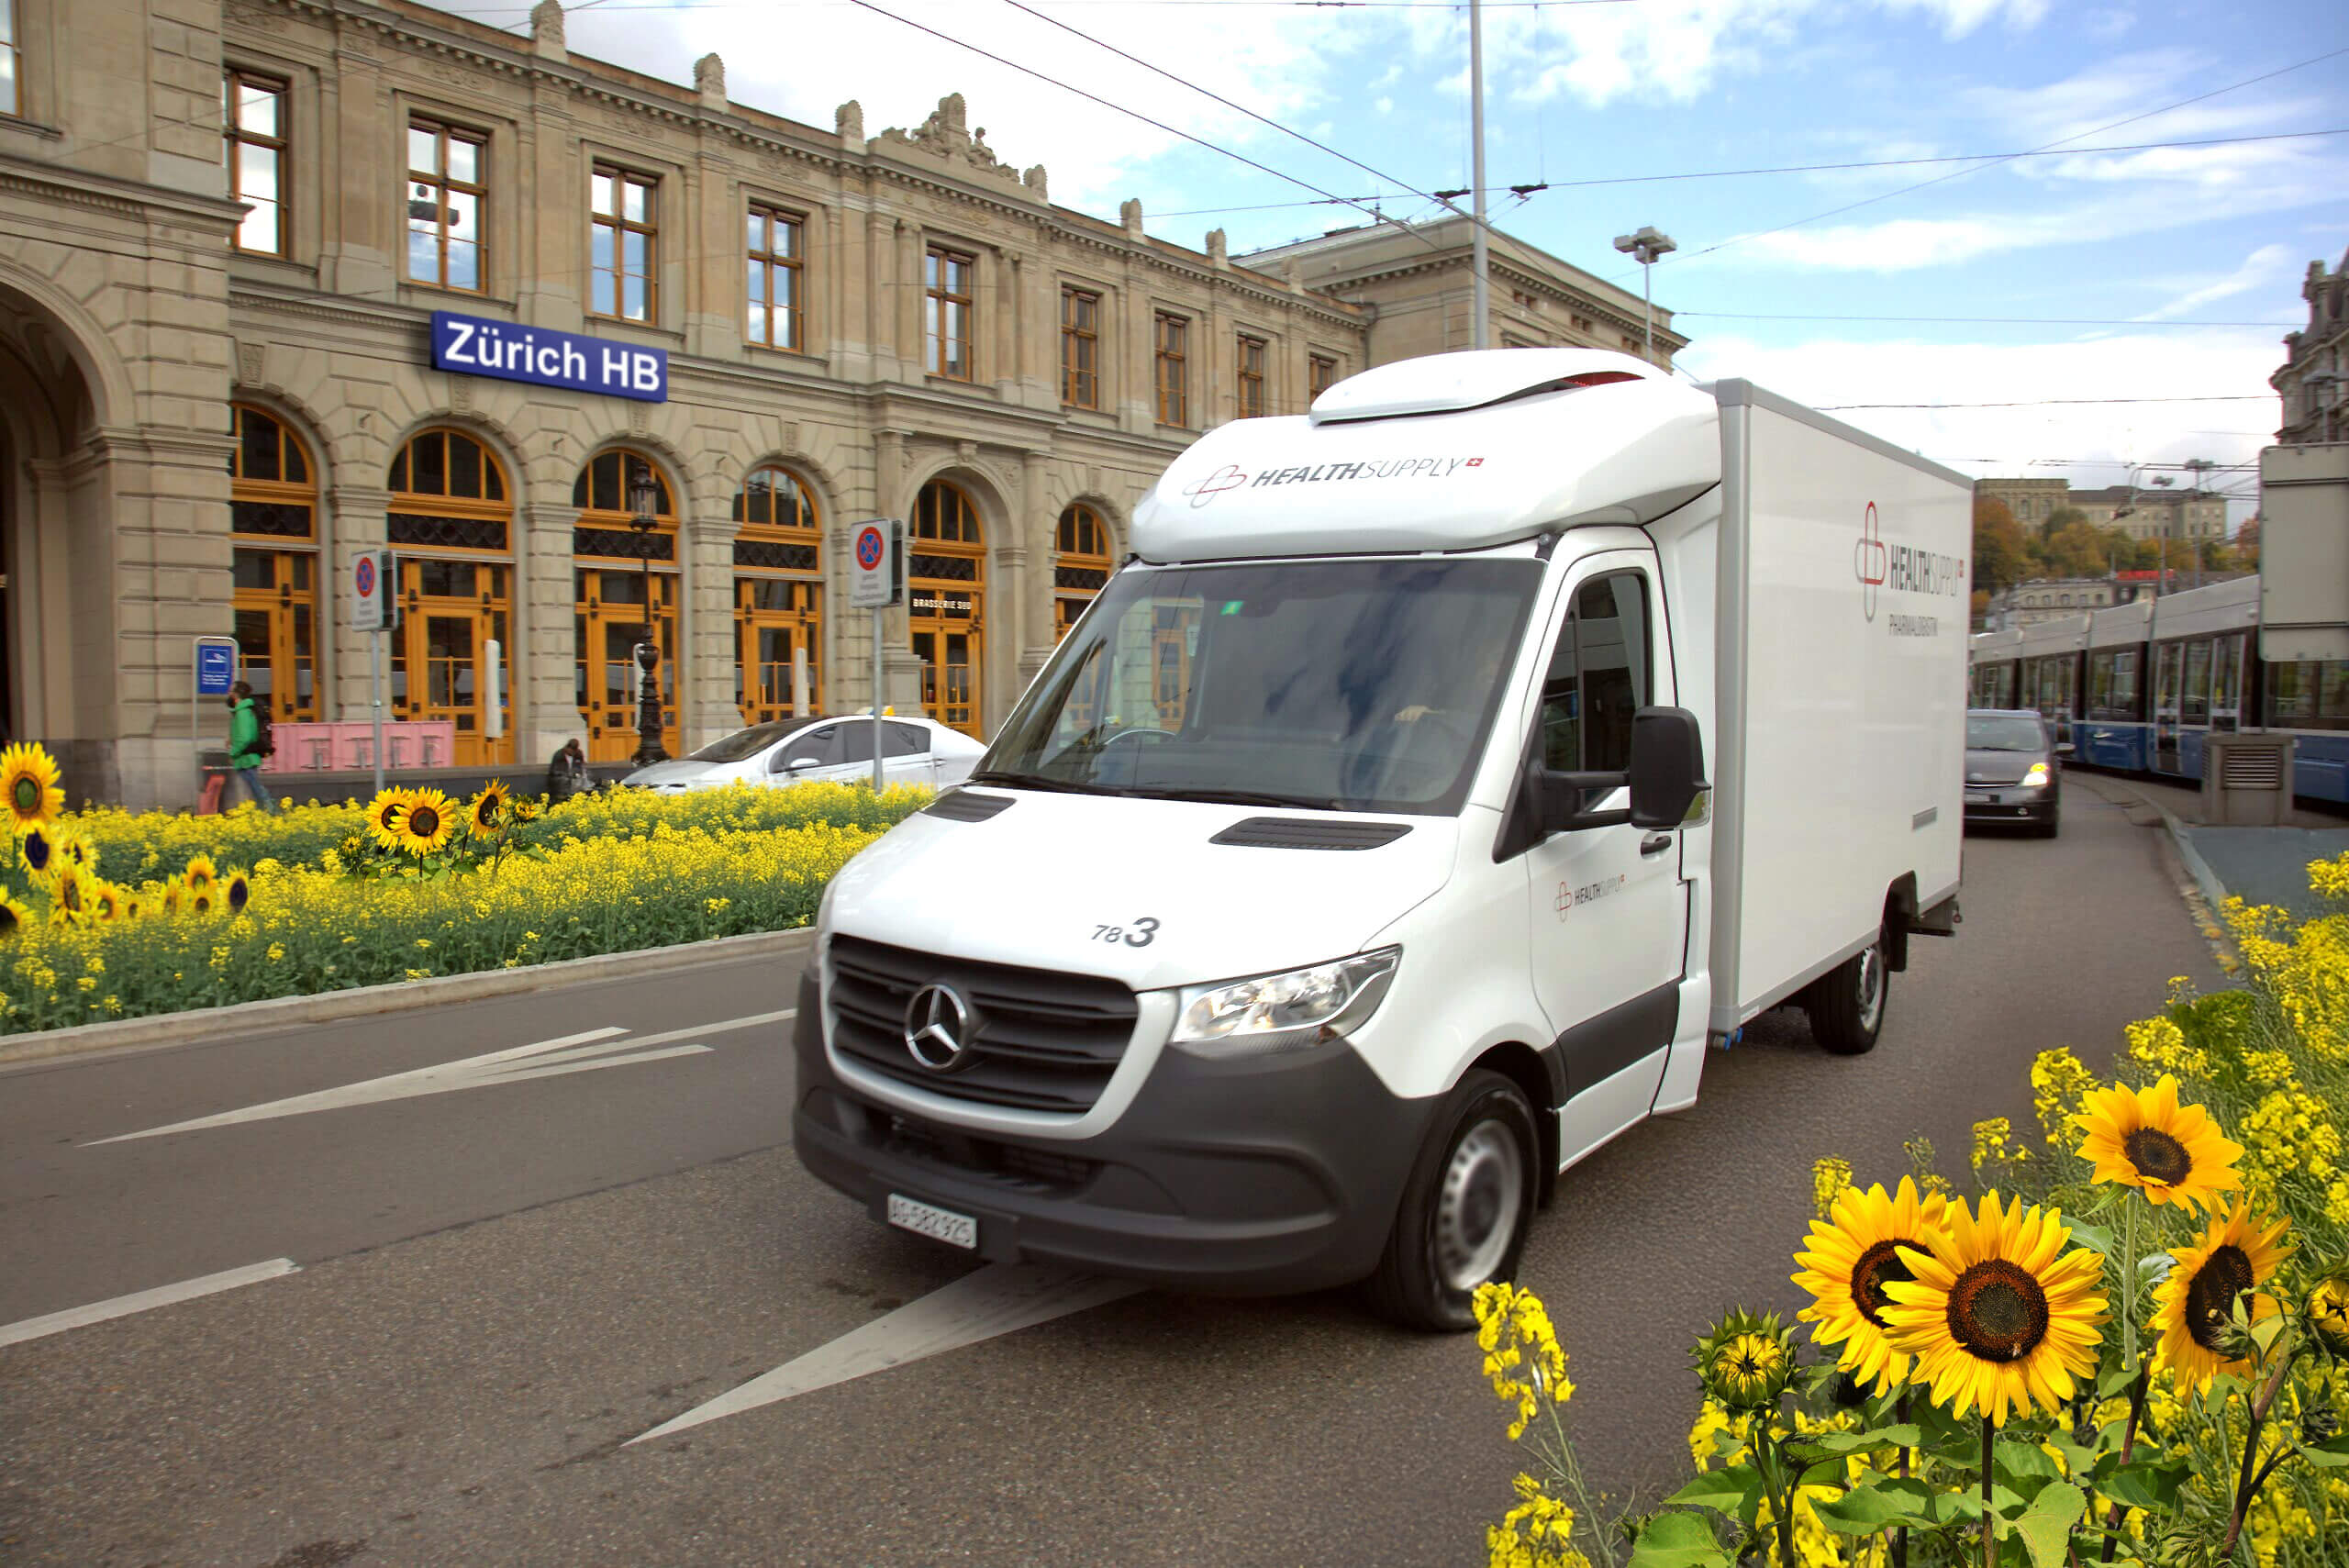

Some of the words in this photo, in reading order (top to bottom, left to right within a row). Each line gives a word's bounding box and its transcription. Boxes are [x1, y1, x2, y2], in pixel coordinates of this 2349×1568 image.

[445, 320, 587, 381] Zürich
[602, 347, 660, 392] HB
[1251, 457, 1465, 488] HEALTHSUPPLY
[912, 598, 956, 609] BRASSERIE
